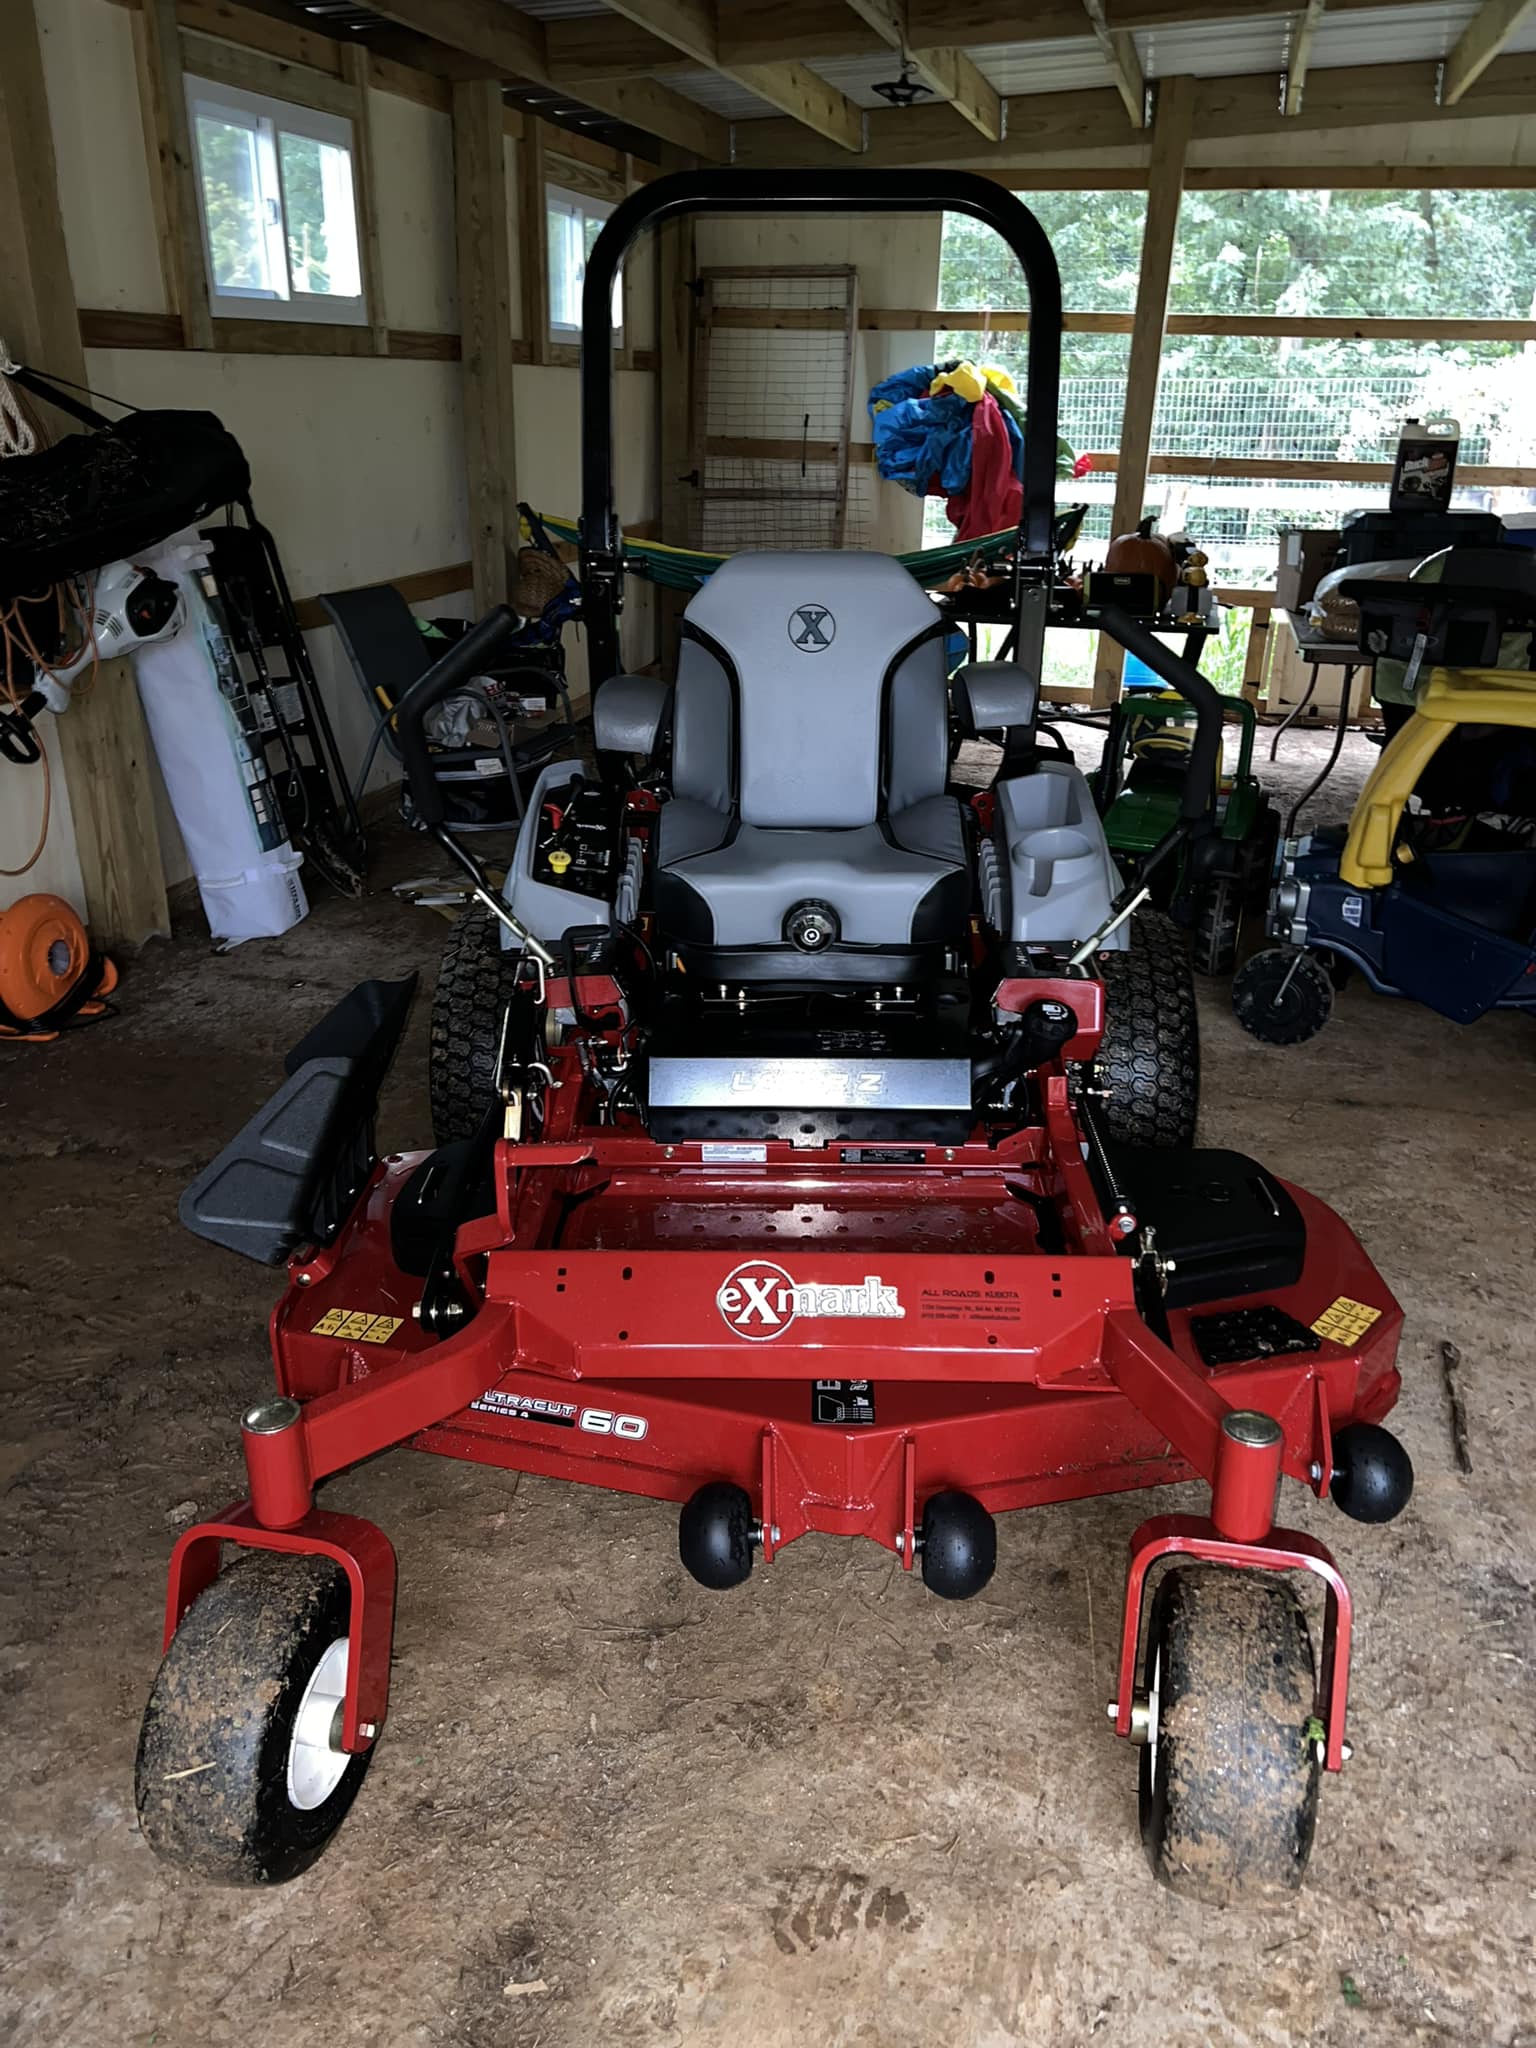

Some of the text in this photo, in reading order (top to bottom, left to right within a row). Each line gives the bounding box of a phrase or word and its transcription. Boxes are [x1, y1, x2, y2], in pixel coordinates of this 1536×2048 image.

[856, 1070, 885, 1094] Z
[921, 1288, 939, 1297] ALL
[942, 1289, 980, 1298] ROADS
[483, 1390, 649, 1441] LTRACUT 60
